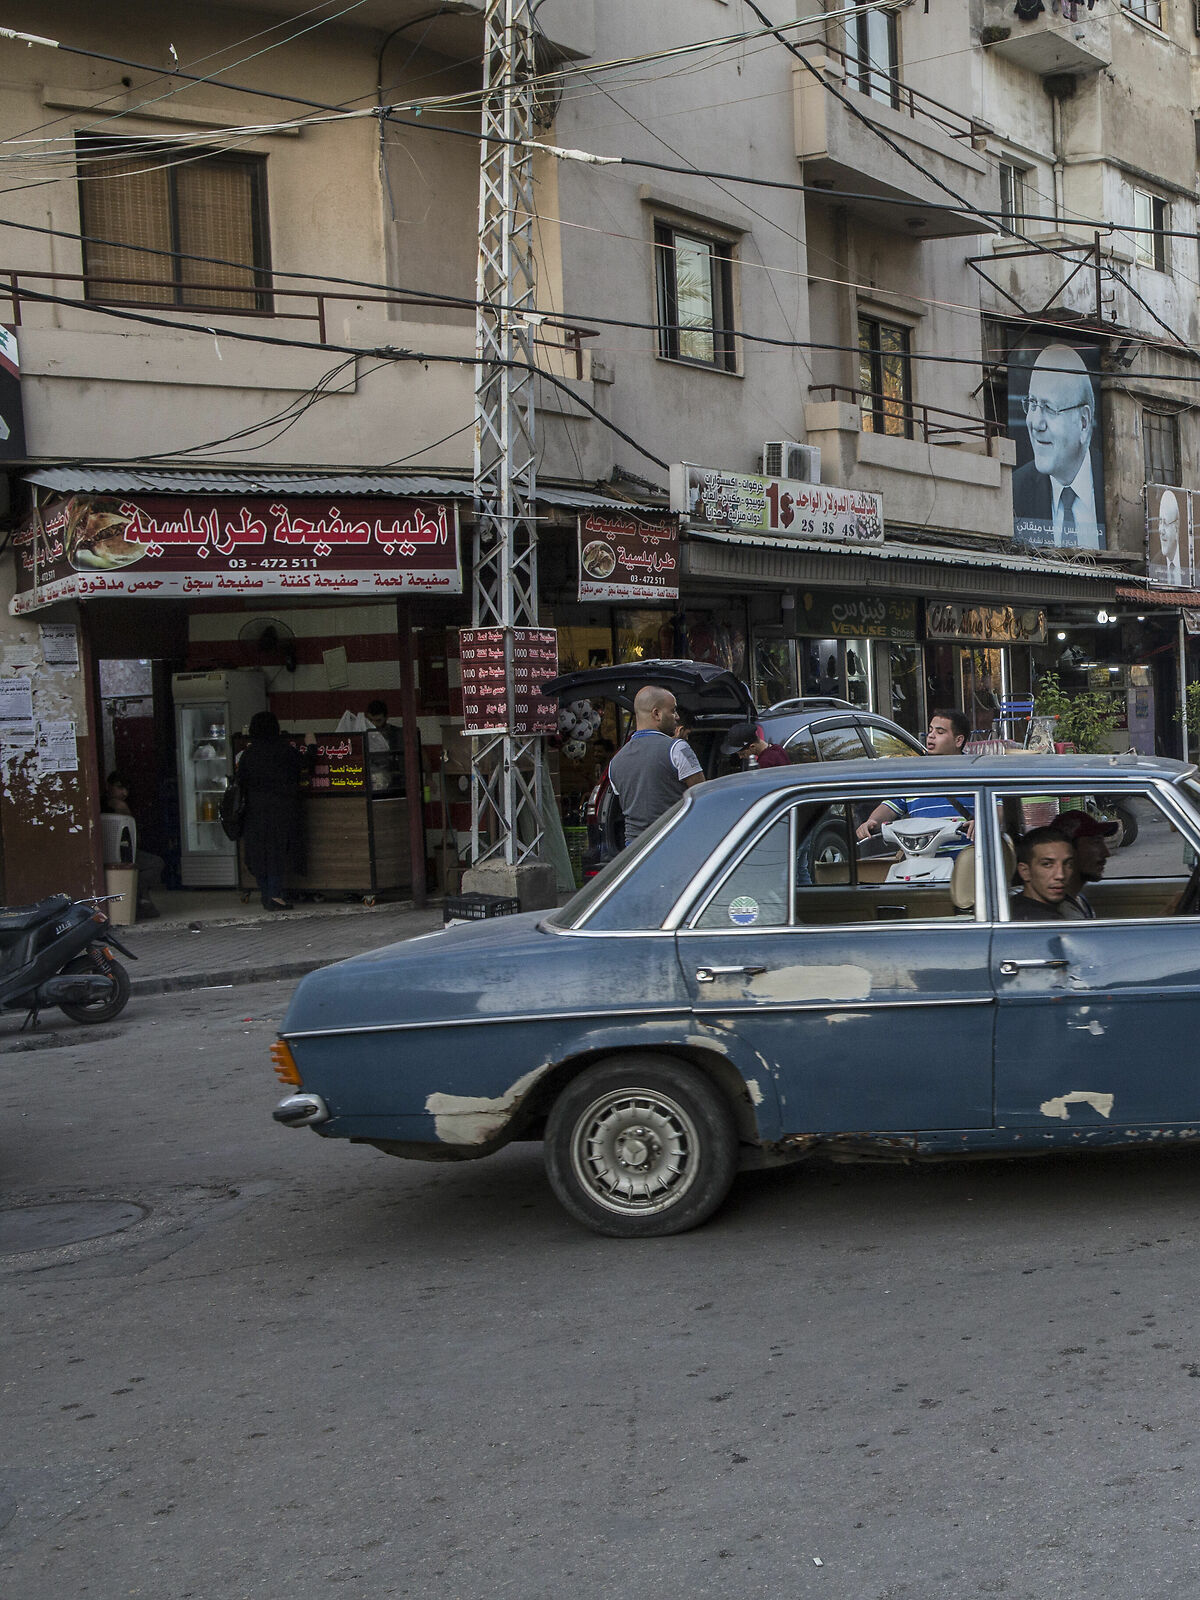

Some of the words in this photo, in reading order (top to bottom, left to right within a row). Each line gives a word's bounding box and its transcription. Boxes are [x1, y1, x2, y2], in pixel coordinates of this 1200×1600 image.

[742, 479, 764, 495] خرضوات
[796, 489, 822, 513] الواحد
[823, 491, 849, 516] الدولار
[849, 495, 878, 520] مدينة
[728, 509, 746, 525] منزلية
[119, 502, 267, 558] طرابلسية
[269, 503, 371, 556] صفيحة
[375, 504, 448, 555] أطيب
[639, 519, 677, 544] أطيب
[801, 518, 815, 533] 2$
[822, 521, 835, 535] 3$
[842, 524, 855, 537] 4$
[1016, 521, 1043, 534] ميقاتي
[229, 558, 247, 568] 03
[259, 558, 288, 568] 472
[291, 558, 318, 568] 511
[617, 546, 676, 573] طرابلسية
[78, 576, 125, 593] مدقوق
[127, 577, 164, 593] حمص
[182, 574, 214, 592] سجق
[216, 573, 264, 592] صفيحة
[279, 573, 311, 588] كفتة
[313, 572, 358, 591] صفيحة
[374, 571, 405, 587] لحمة
[408, 571, 450, 590] صفيحة
[630, 575, 638, 583] 03
[643, 575, 654, 584] 472
[654, 576, 665, 585] 511
[463, 633, 474, 642] 500
[514, 632, 526, 641] 500
[831, 621, 888, 636] VENUSE
[890, 626, 915, 638] Shoes
[514, 648, 527, 658] 1000
[515, 668, 528, 677] 1000
[514, 684, 528, 694] 1000
[515, 704, 528, 714] 1000
[325, 738, 353, 760] أطيب
